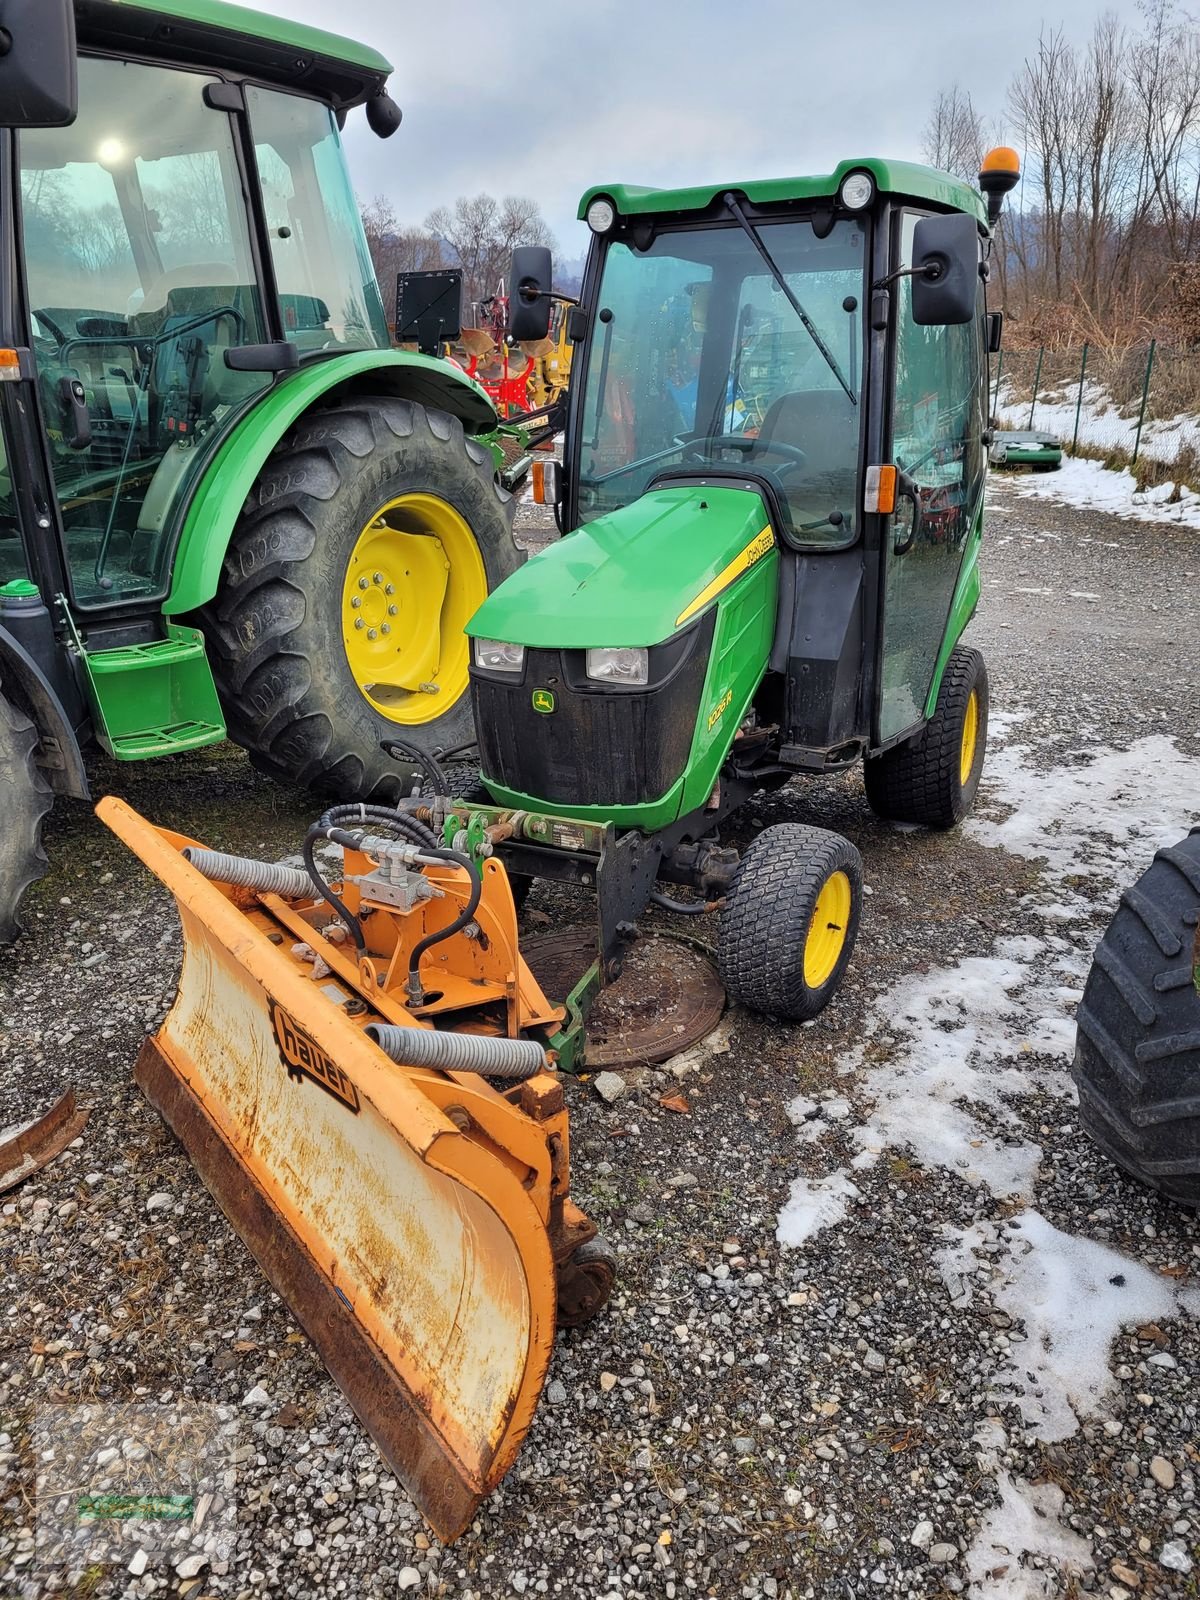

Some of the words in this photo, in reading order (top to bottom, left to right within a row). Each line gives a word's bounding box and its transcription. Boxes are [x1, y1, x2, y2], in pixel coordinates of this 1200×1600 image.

[746, 544, 761, 565] JOHN
[758, 534, 774, 553] DEERE
[278, 1010, 350, 1096] hauer
